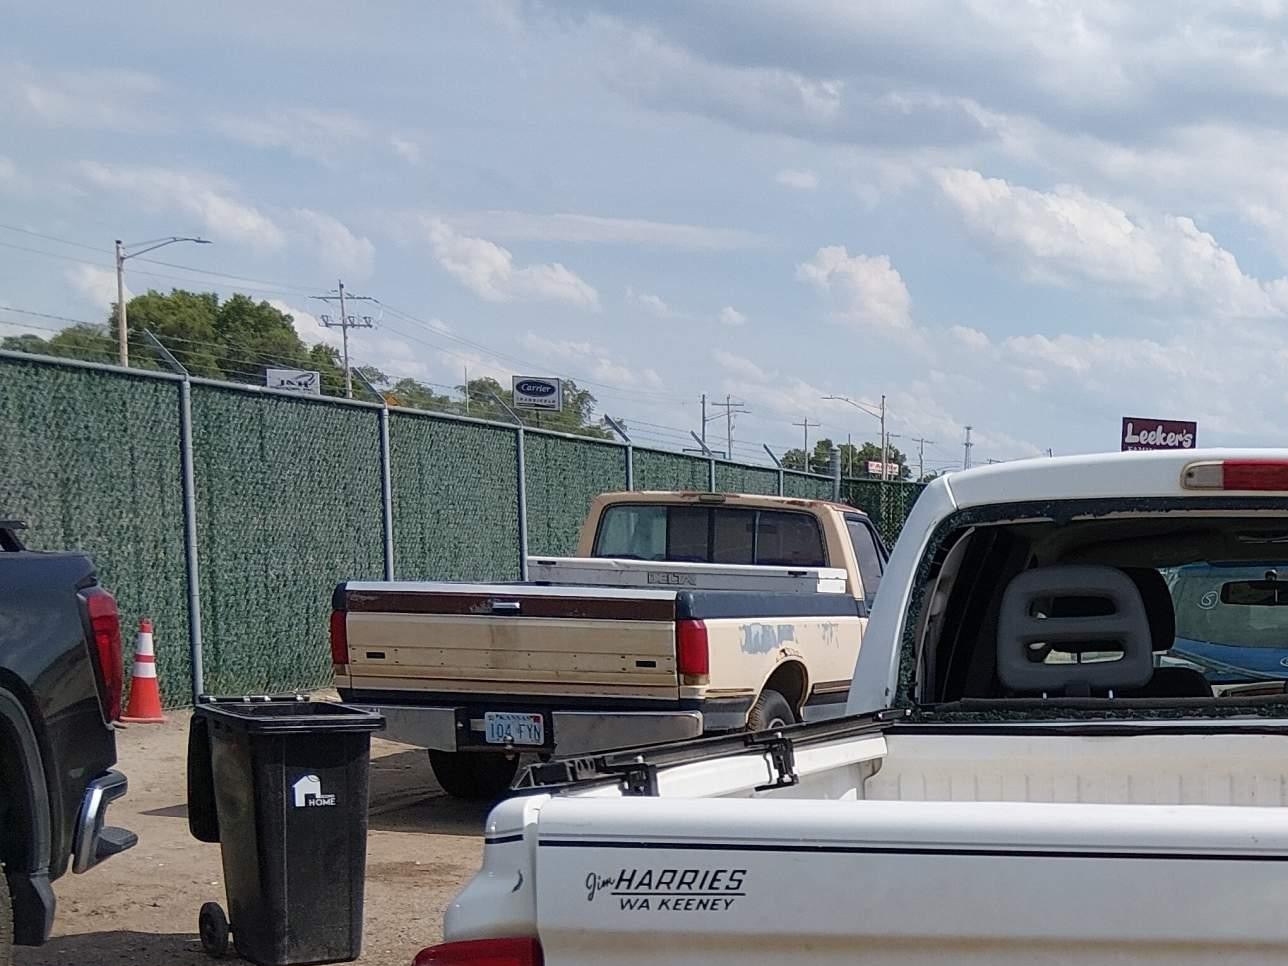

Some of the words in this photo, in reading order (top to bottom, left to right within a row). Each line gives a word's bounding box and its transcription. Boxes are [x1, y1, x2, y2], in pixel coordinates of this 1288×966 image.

[521, 383, 552, 393] Carrier
[1124, 422, 1194, 448] Leeker's
[647, 571, 697, 586] DELTA
[489, 723, 512, 738] 104
[519, 723, 542, 740] FYN
[308, 798, 336, 807] HOME
[585, 872, 616, 902] Jim
[614, 868, 748, 891] HARRIES
[619, 898, 651, 911] WA
[657, 898, 736, 911] KEENEY
